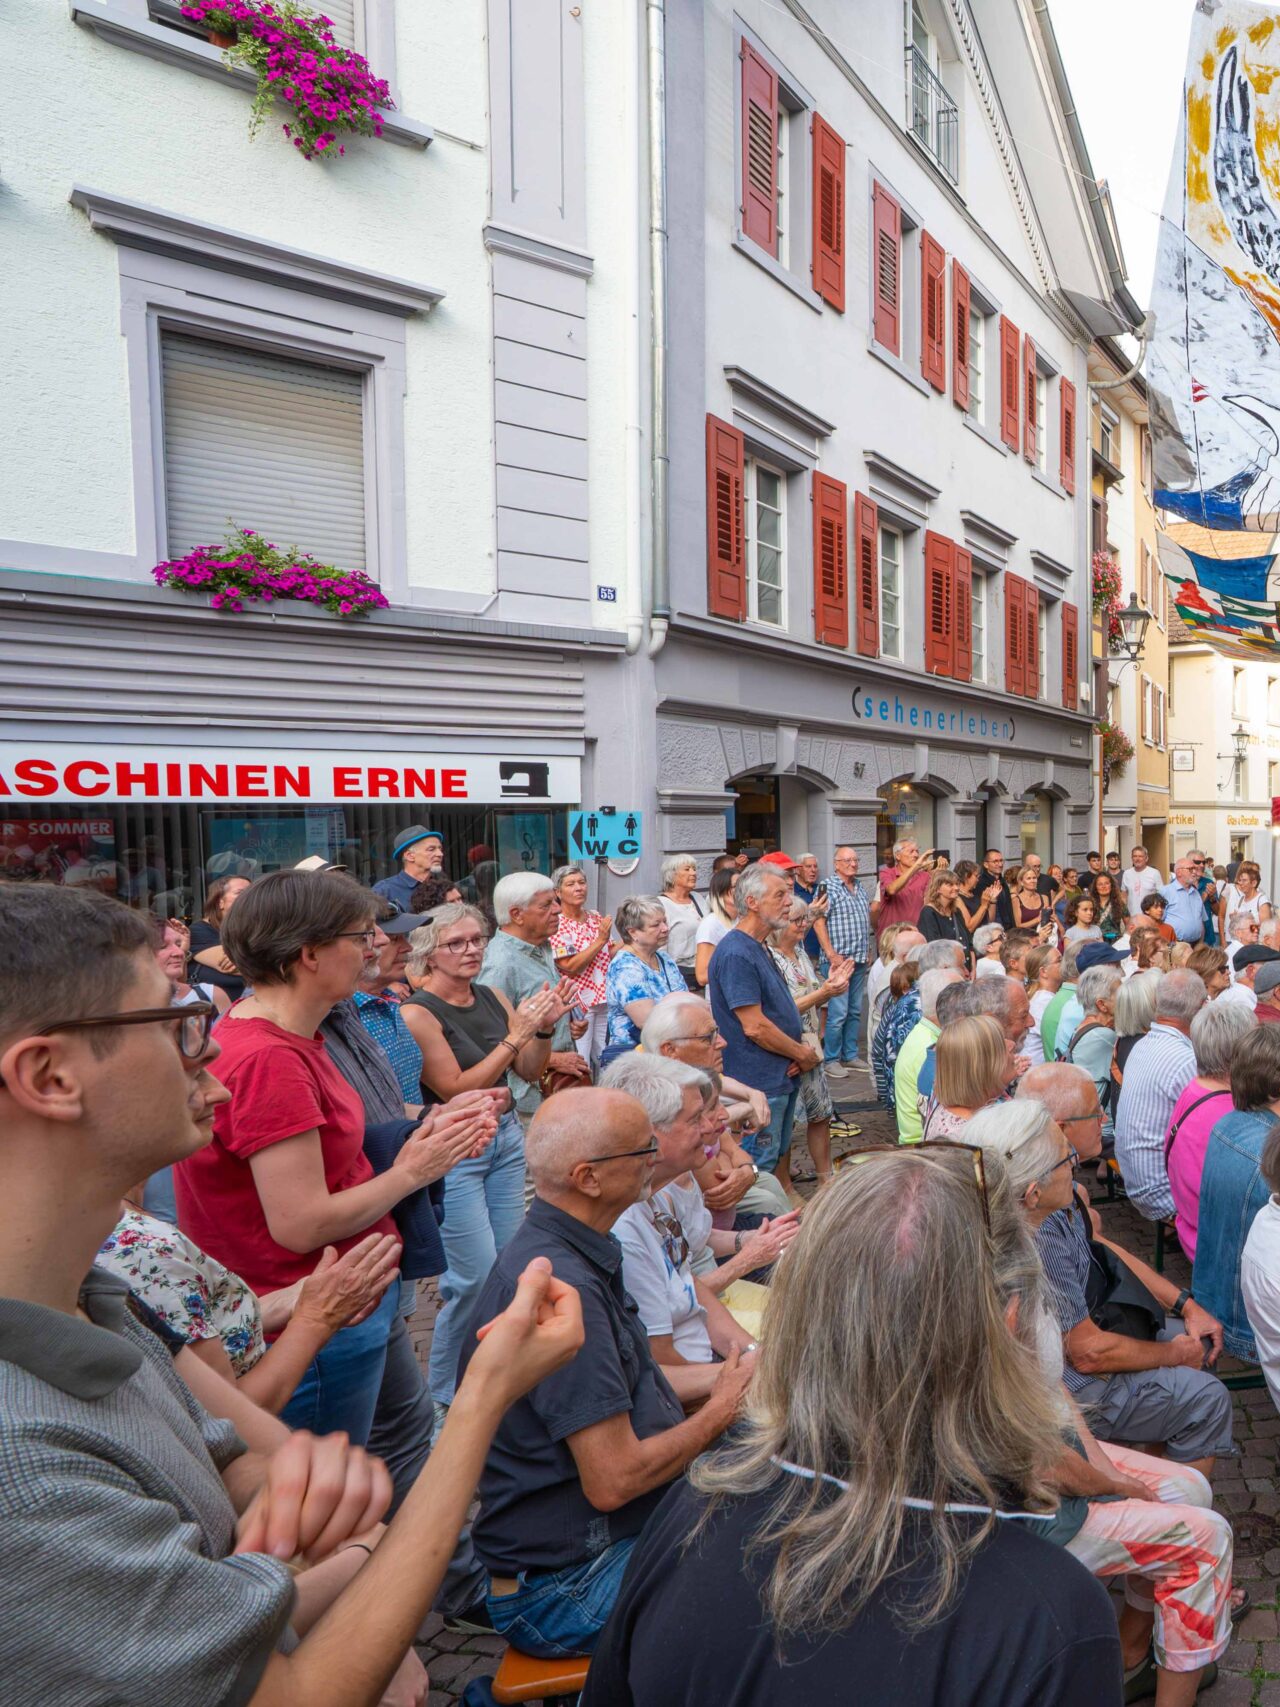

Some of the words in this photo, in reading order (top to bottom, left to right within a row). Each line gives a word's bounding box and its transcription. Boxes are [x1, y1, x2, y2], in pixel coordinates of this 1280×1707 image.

[600, 588, 615, 600] 55
[0, 759, 311, 797] SCHINEN
[333, 766, 468, 798] ERNE
[28, 822, 111, 837] SOMMER
